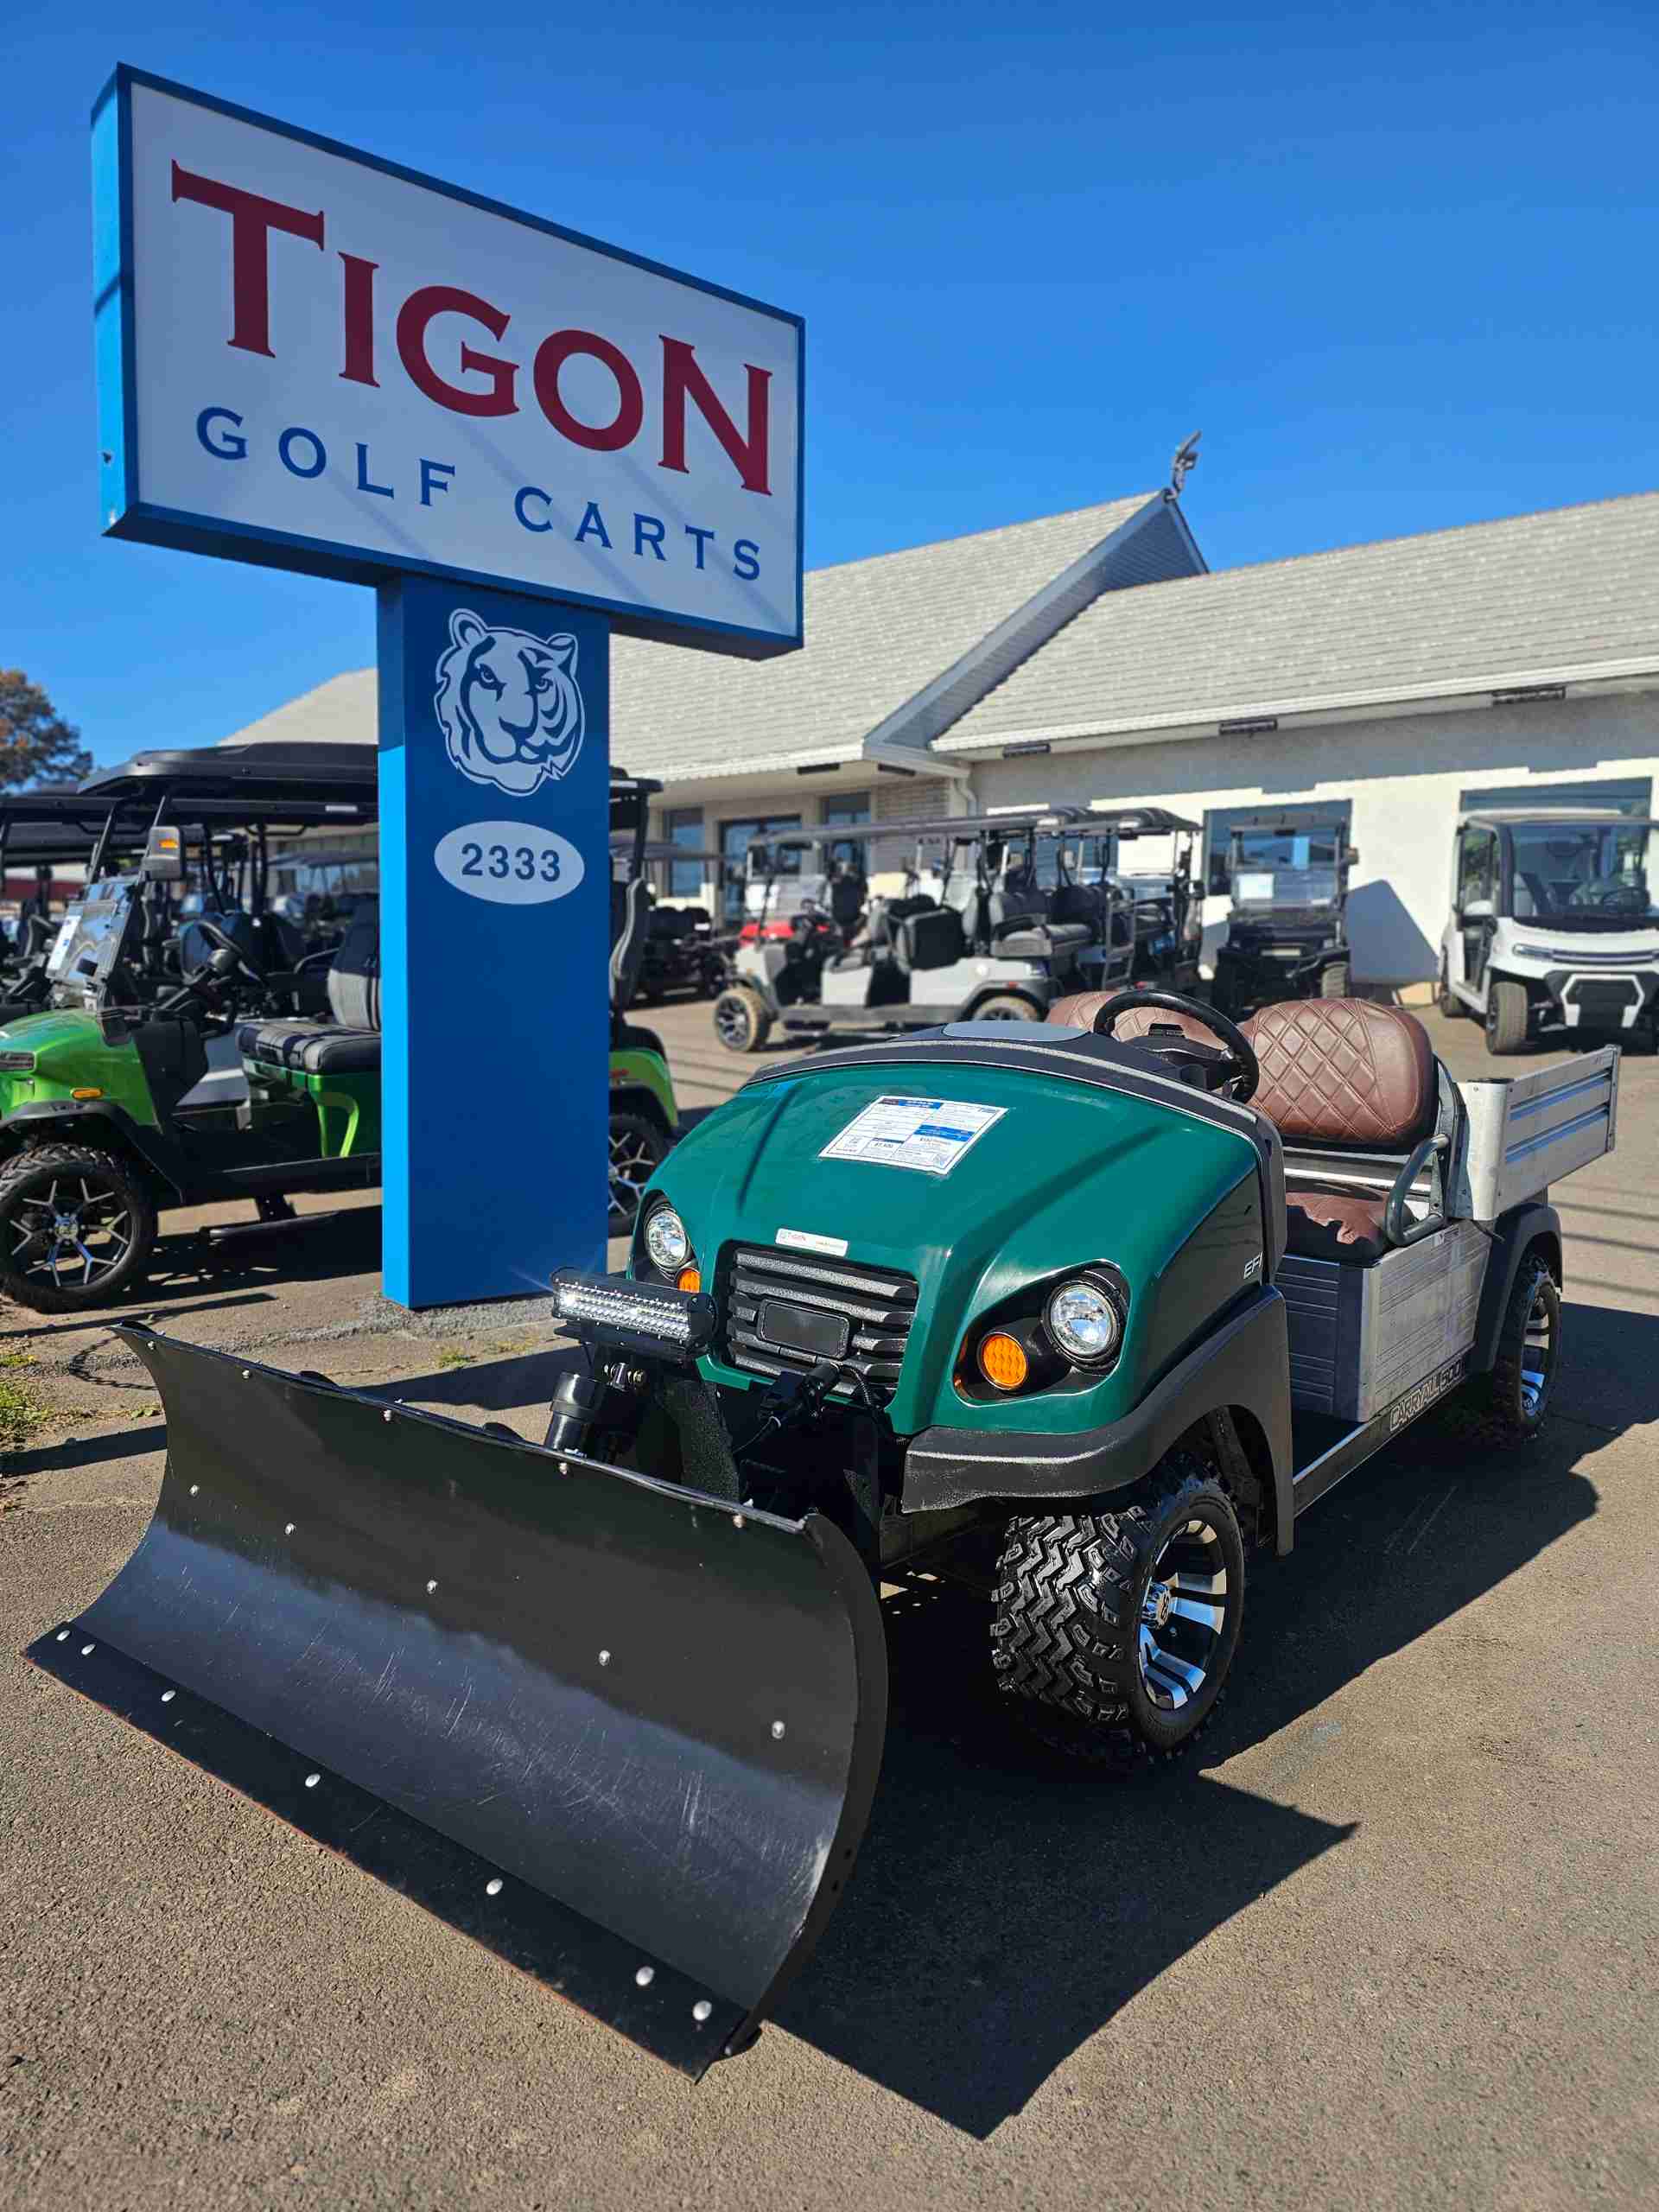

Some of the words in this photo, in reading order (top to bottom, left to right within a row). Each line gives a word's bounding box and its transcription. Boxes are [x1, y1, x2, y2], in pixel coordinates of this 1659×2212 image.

[172, 159, 772, 496] TIGON
[196, 406, 455, 507] GOLF
[514, 486, 762, 582] CARTS
[461, 842, 561, 882] 2333
